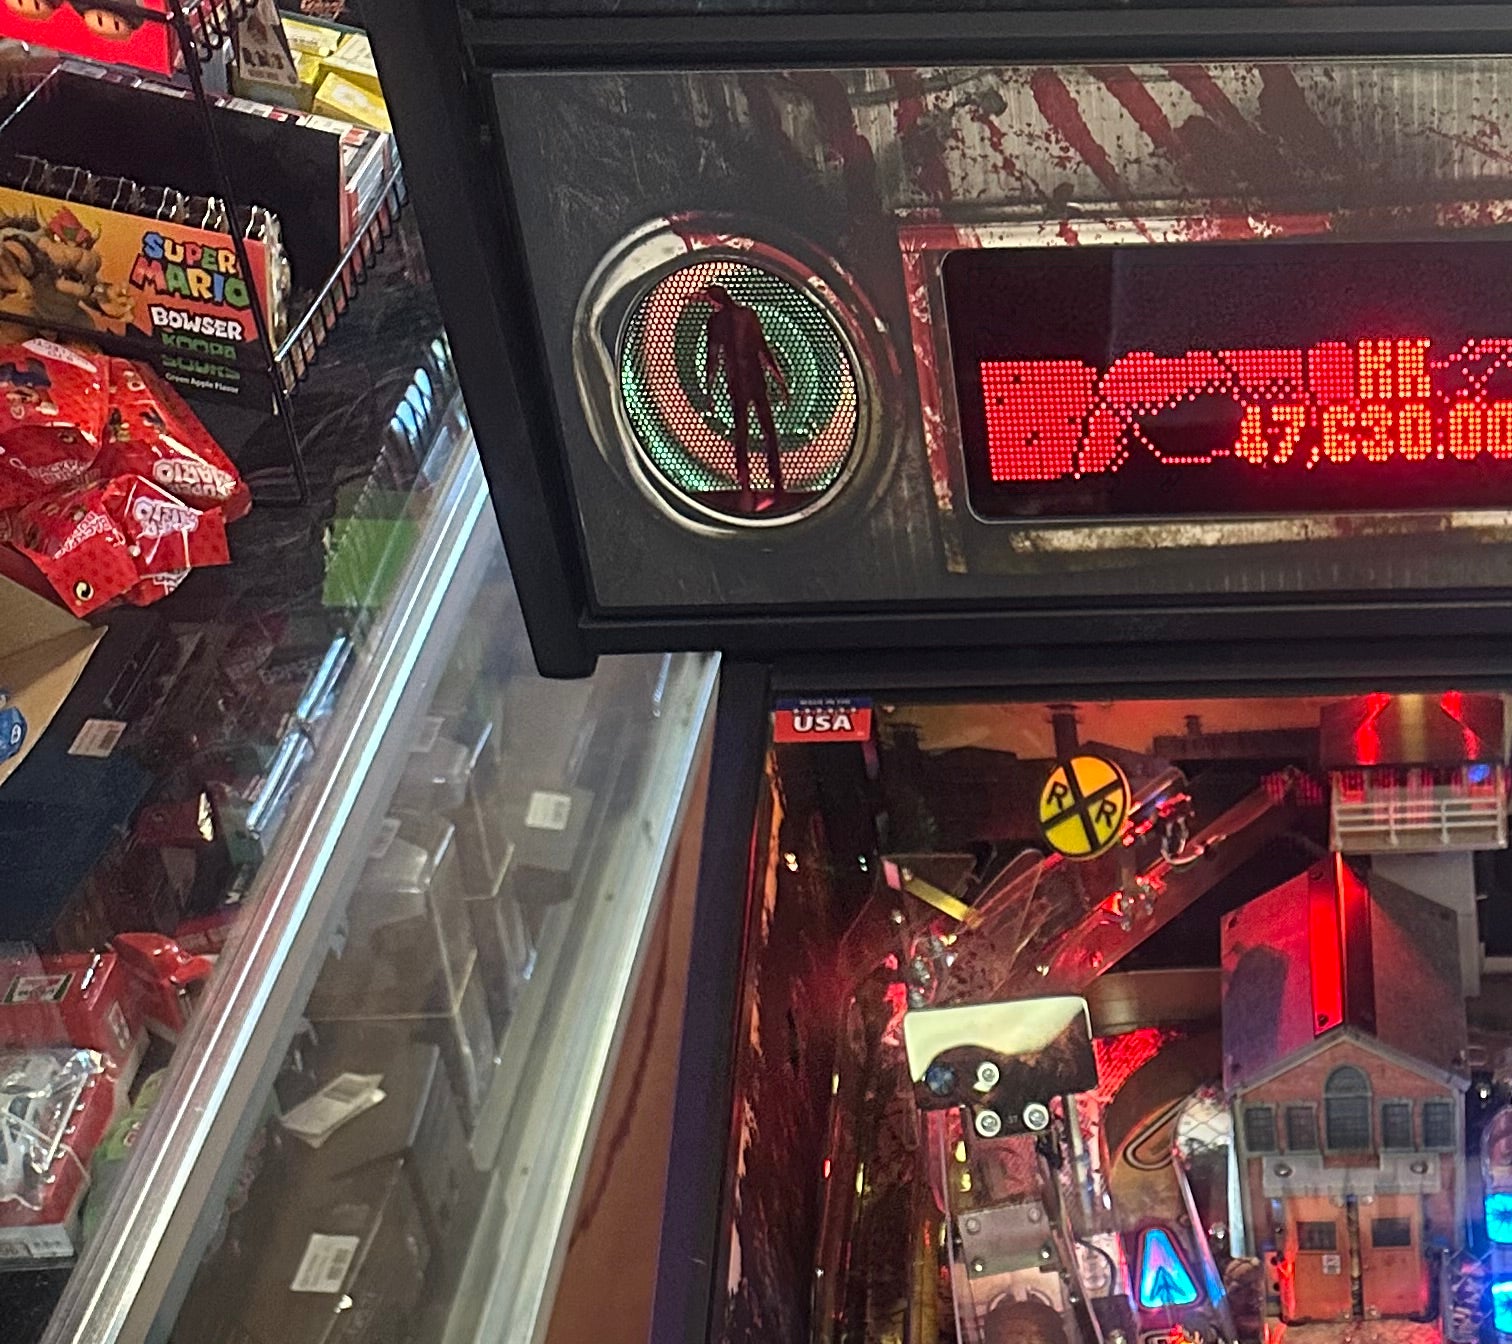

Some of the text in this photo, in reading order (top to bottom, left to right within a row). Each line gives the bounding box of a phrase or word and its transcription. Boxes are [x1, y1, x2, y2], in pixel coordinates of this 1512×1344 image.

[143, 232, 236, 274] SUPER
[130, 254, 250, 308] MARIO
[150, 306, 242, 341] BOWSER
[793, 715, 852, 732] USA
[1046, 780, 1118, 829] R R
